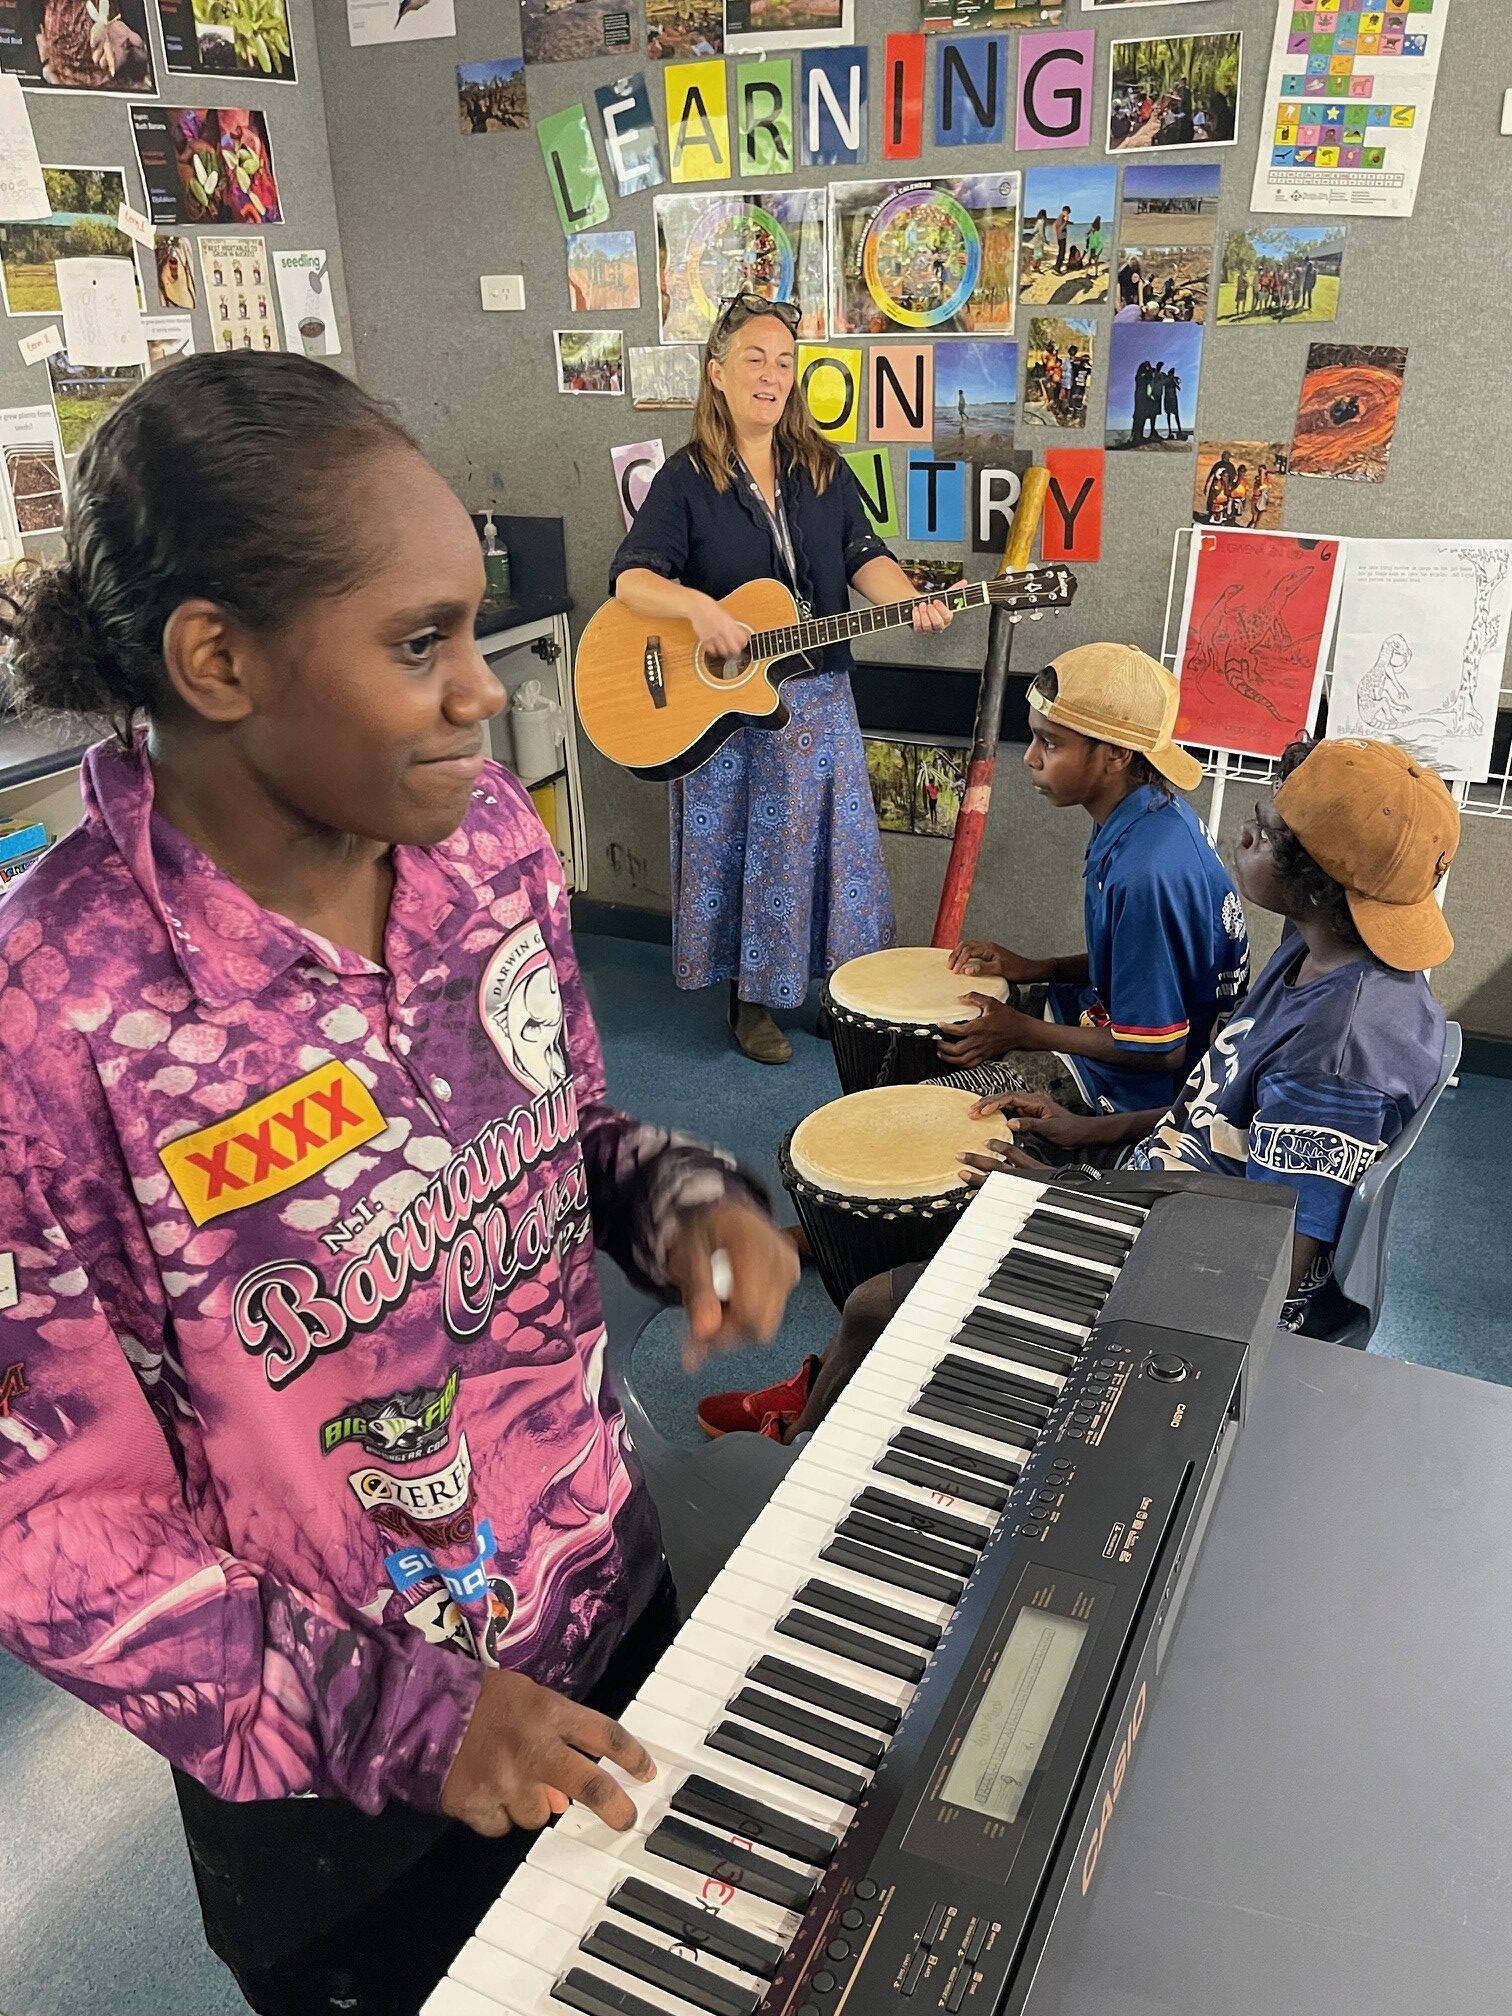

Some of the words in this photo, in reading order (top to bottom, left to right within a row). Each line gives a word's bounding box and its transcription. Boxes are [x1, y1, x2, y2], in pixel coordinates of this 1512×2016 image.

[551, 41, 1084, 222] LEARNING
[281, 255, 320, 270] seedling
[799, 354, 925, 430] ON
[622, 453, 1095, 550] CNTRY
[1320, 544, 1332, 561] 6
[493, 939, 530, 996] DARWIN
[184, 1078, 365, 1201] XXXX
[322, 1197, 384, 1256] N.T.
[325, 1417, 367, 1450] BIG
[1169, 1402, 1187, 1428] CASIO
[1082, 1681, 1146, 1896] CASIO
